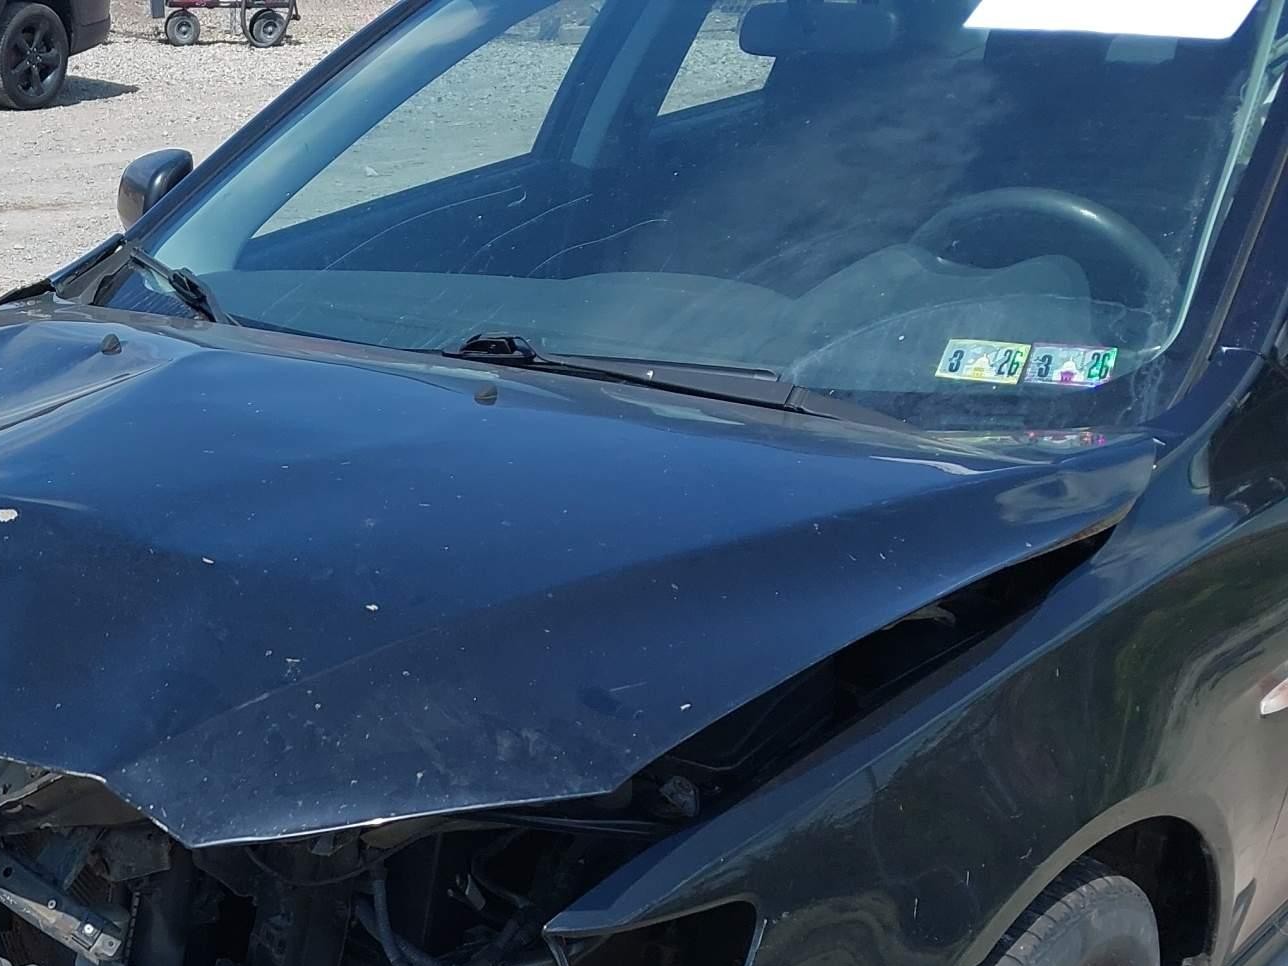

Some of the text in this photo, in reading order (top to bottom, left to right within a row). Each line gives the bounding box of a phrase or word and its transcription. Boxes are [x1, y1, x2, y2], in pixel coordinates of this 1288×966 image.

[948, 349, 1024, 377] 3 26
[1037, 352, 1111, 380] 3 26
